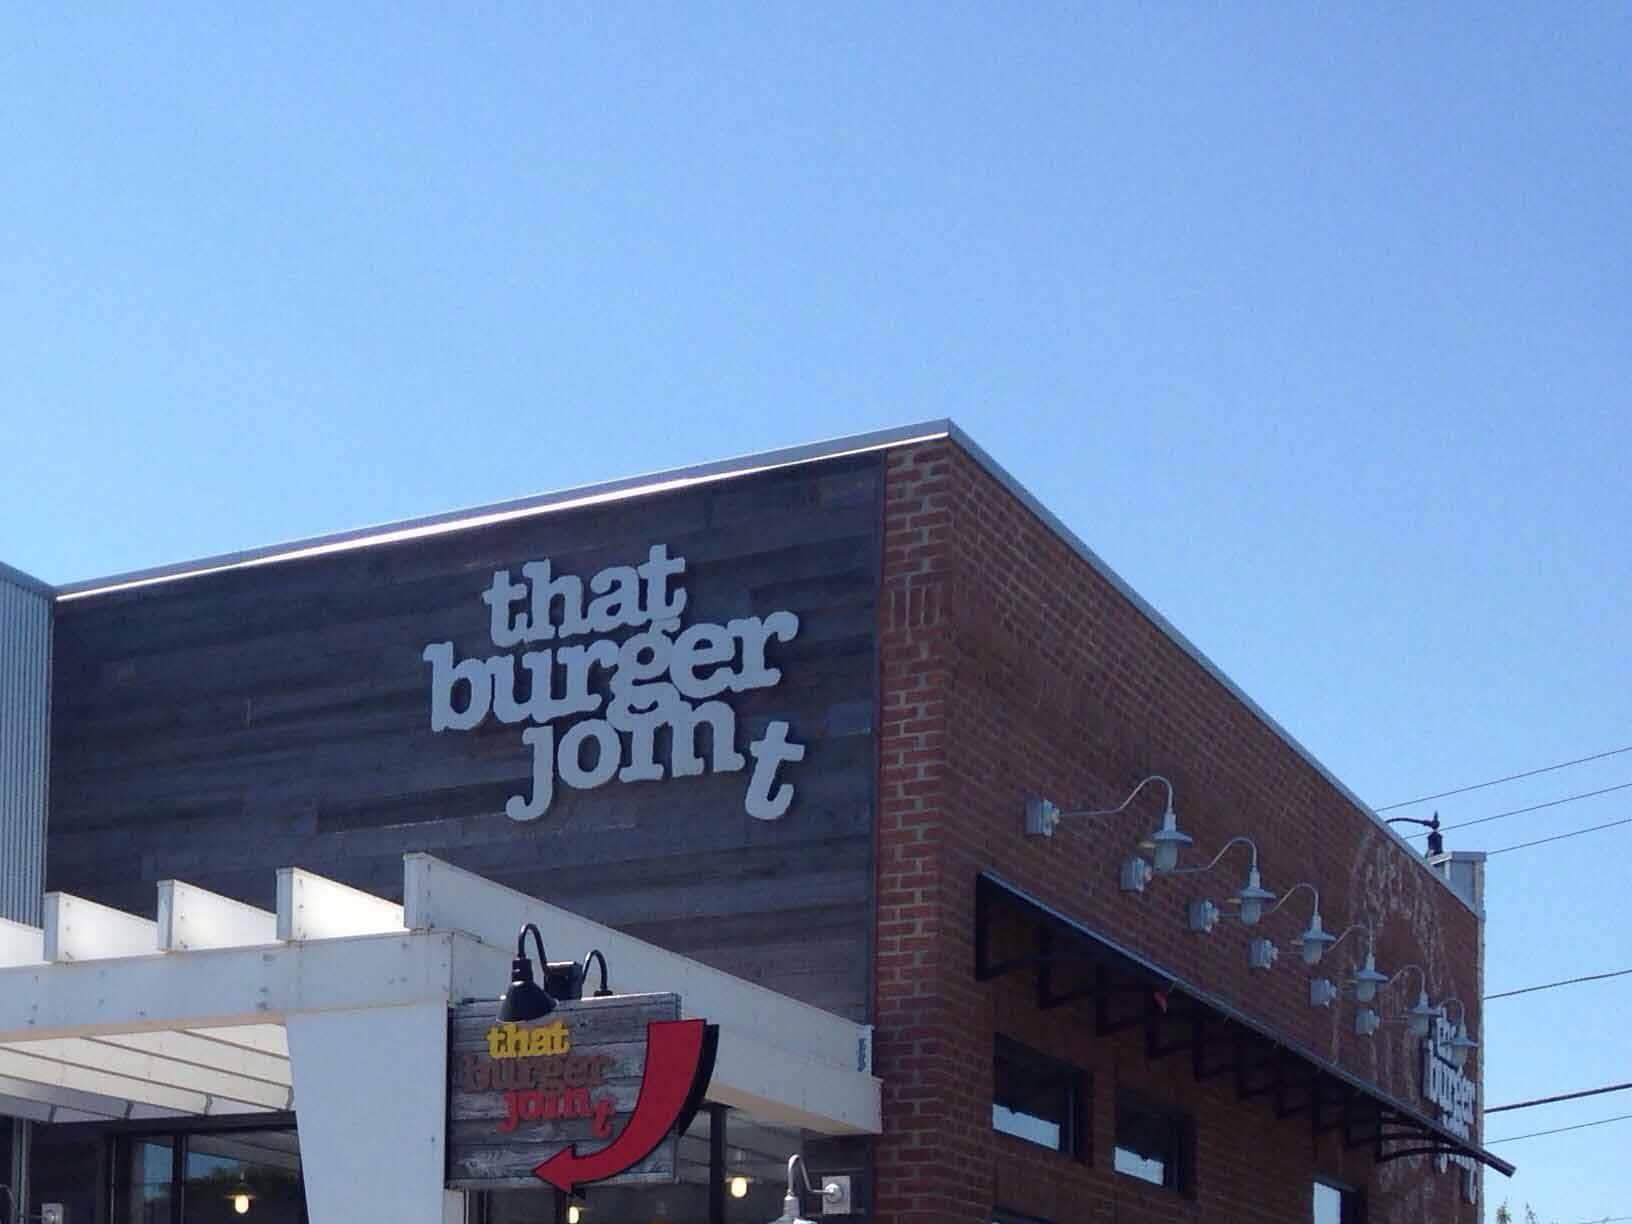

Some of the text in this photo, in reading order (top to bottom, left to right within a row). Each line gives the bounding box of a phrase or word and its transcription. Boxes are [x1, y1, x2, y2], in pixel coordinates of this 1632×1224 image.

[481, 544, 688, 648] that
[422, 611, 800, 733] burger
[505, 698, 806, 822] joint
[464, 1053, 612, 1095] burger
[486, 1019, 570, 1058] that
[497, 1086, 616, 1139] joint
